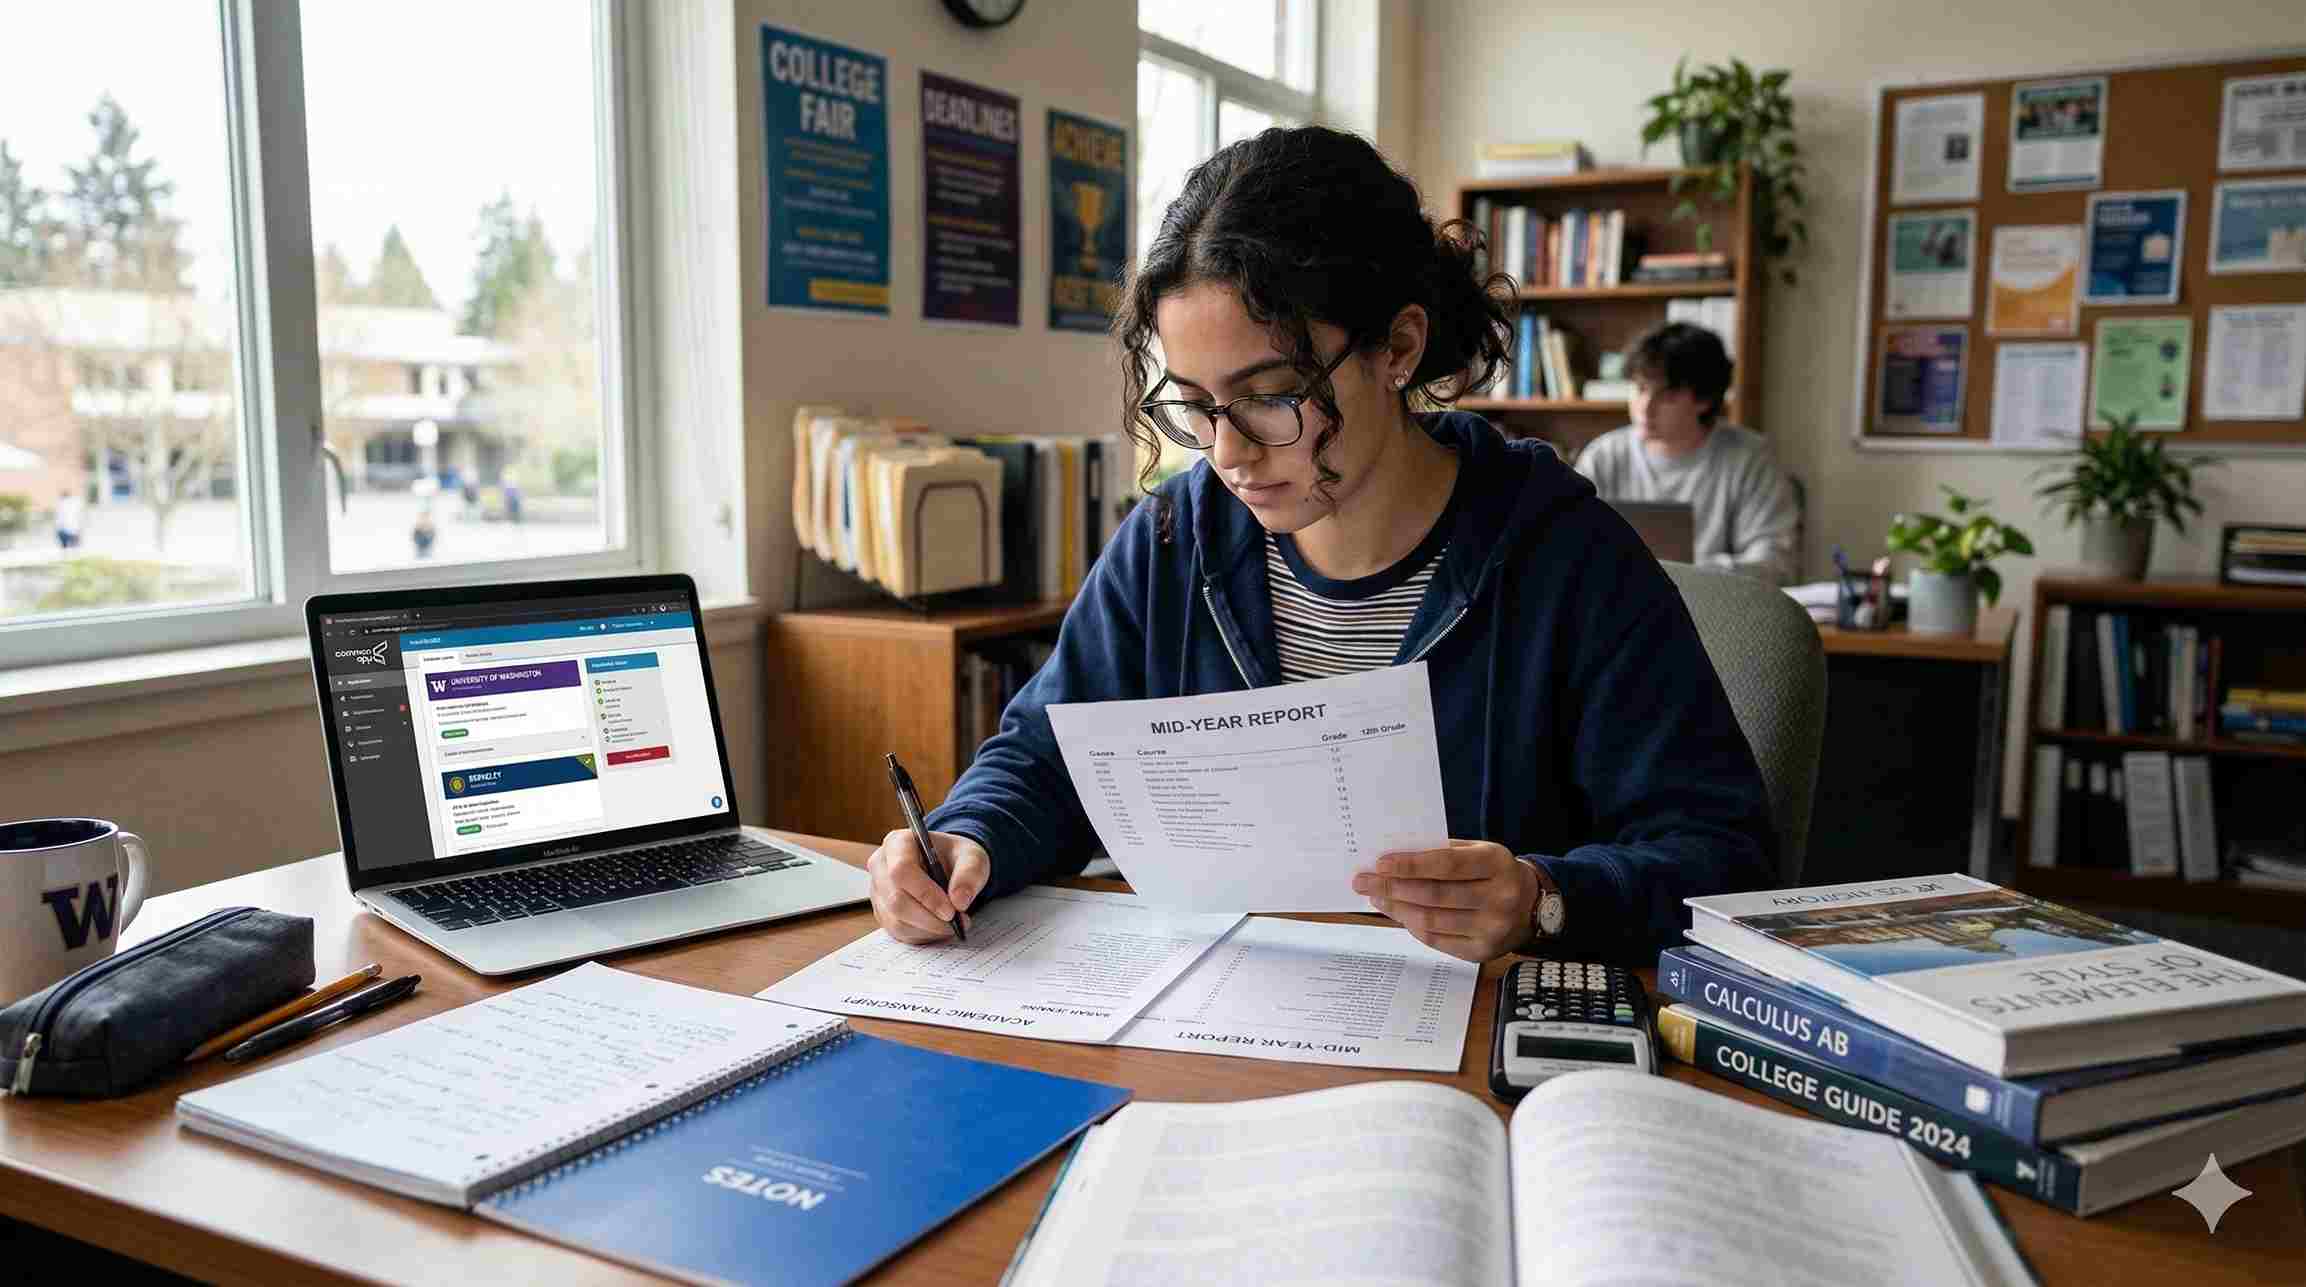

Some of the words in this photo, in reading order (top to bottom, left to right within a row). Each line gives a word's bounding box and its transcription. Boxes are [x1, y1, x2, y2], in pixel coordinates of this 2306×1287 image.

[769, 41, 881, 104] COLLEGE
[801, 93, 857, 141] FAIR
[924, 87, 1017, 142] DEADLINES
[431, 679, 448, 693] W
[450, 674, 488, 686] UNIVERSITY
[489, 673, 498, 682] OF
[499, 669, 542, 681] WASHINGTON
[1151, 715, 1243, 735] MID-YEAR
[1247, 703, 1327, 727] REPORT
[41, 873, 119, 951] W
[2018, 961, 2142, 986] STYLE
[2146, 953, 2203, 972] OF
[2170, 967, 2262, 989] THE
[841, 996, 945, 1017] TRANSCRIPT
[1970, 977, 2180, 1014] ELEMENTS
[946, 1007, 1036, 1027] ACADEMIC
[1704, 982, 1812, 1043] CALCULUS
[1816, 1025, 1849, 1057] AB
[1175, 1031, 1255, 1045] REPORT
[1261, 1039, 1361, 1054] MID-YEAR
[1716, 1045, 1818, 1101] COLLEGE
[1823, 1085, 1903, 1134] GUIDE
[1907, 1115, 1972, 1159] 2024
[702, 1165, 827, 1211] NOTES
